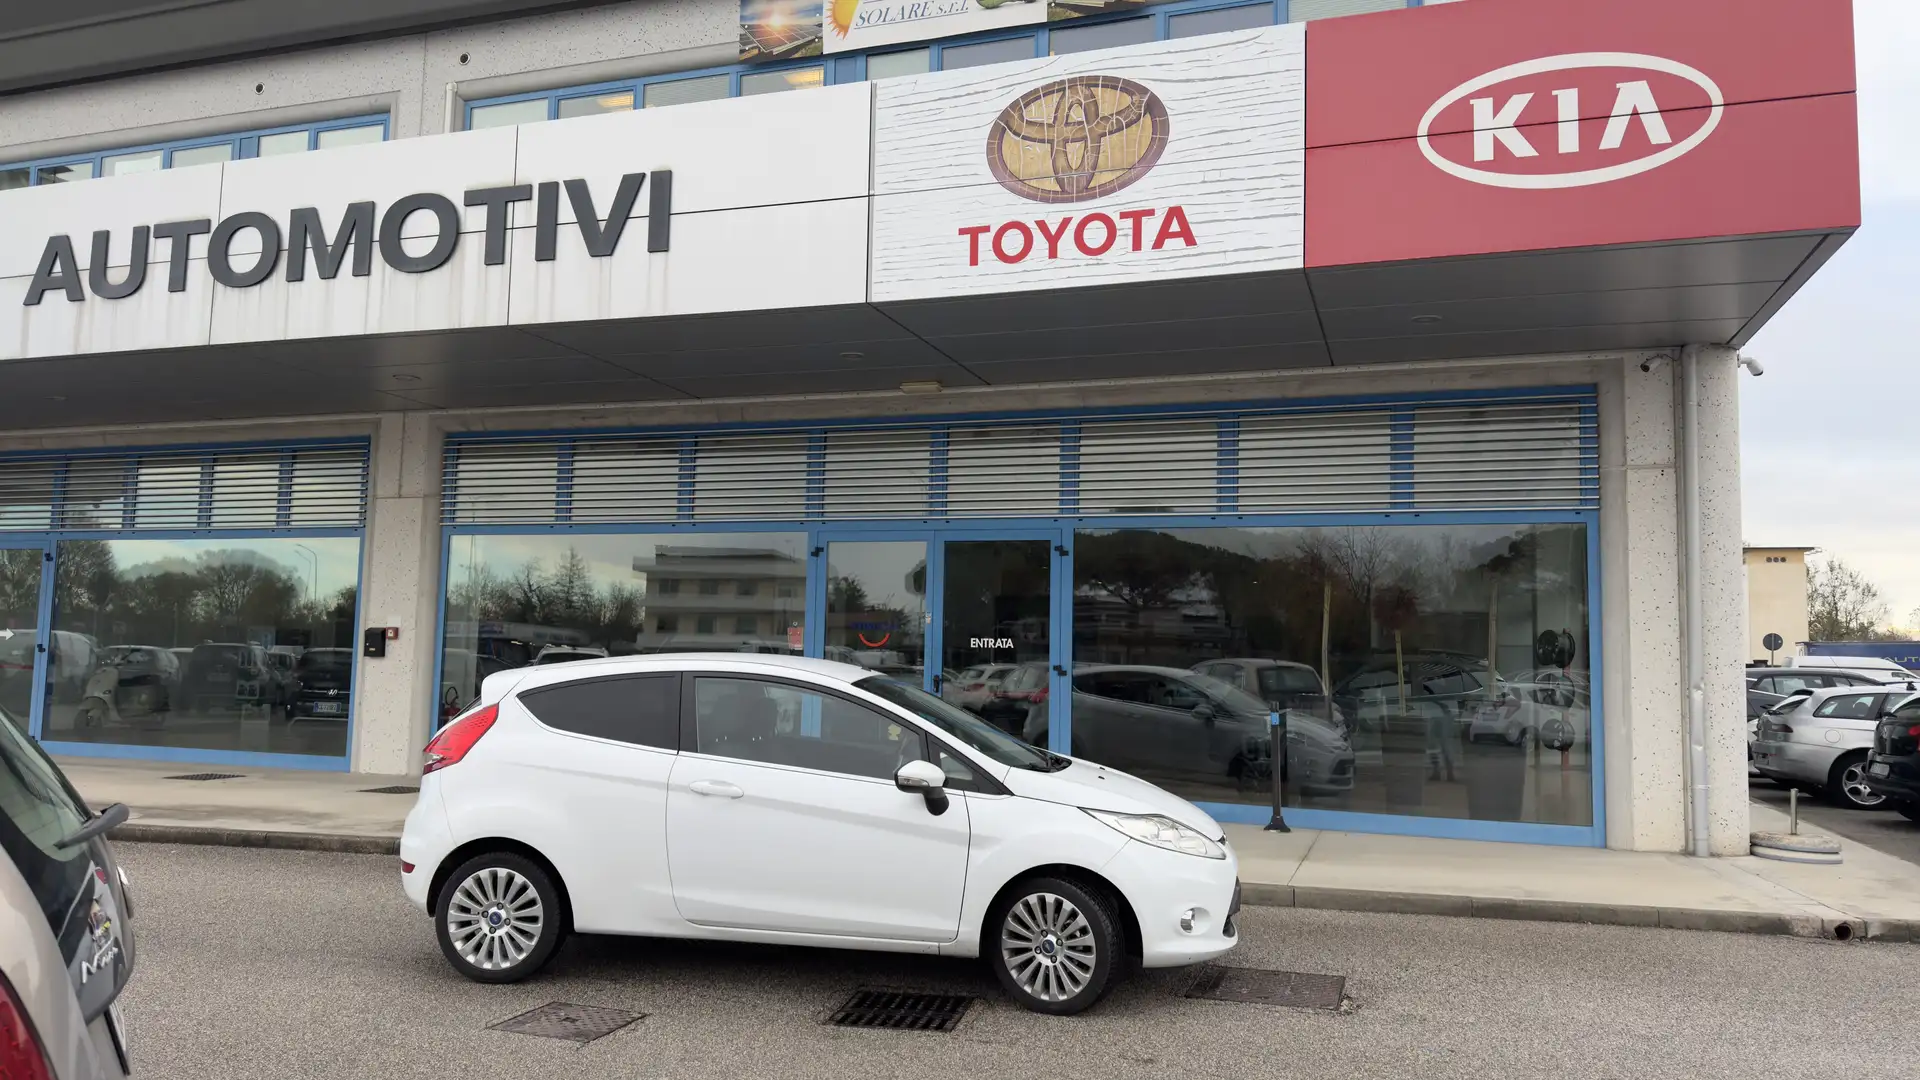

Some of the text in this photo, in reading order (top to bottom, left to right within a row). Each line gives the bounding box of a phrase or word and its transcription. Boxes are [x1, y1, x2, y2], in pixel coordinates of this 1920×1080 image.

[856, 0, 935, 27] SOLARE
[1469, 80, 1673, 162] KIA
[22, 169, 672, 307] AUTOMOTIVI
[958, 205, 1198, 267] TOYOTA
[970, 637, 1014, 649] ENTRATA
